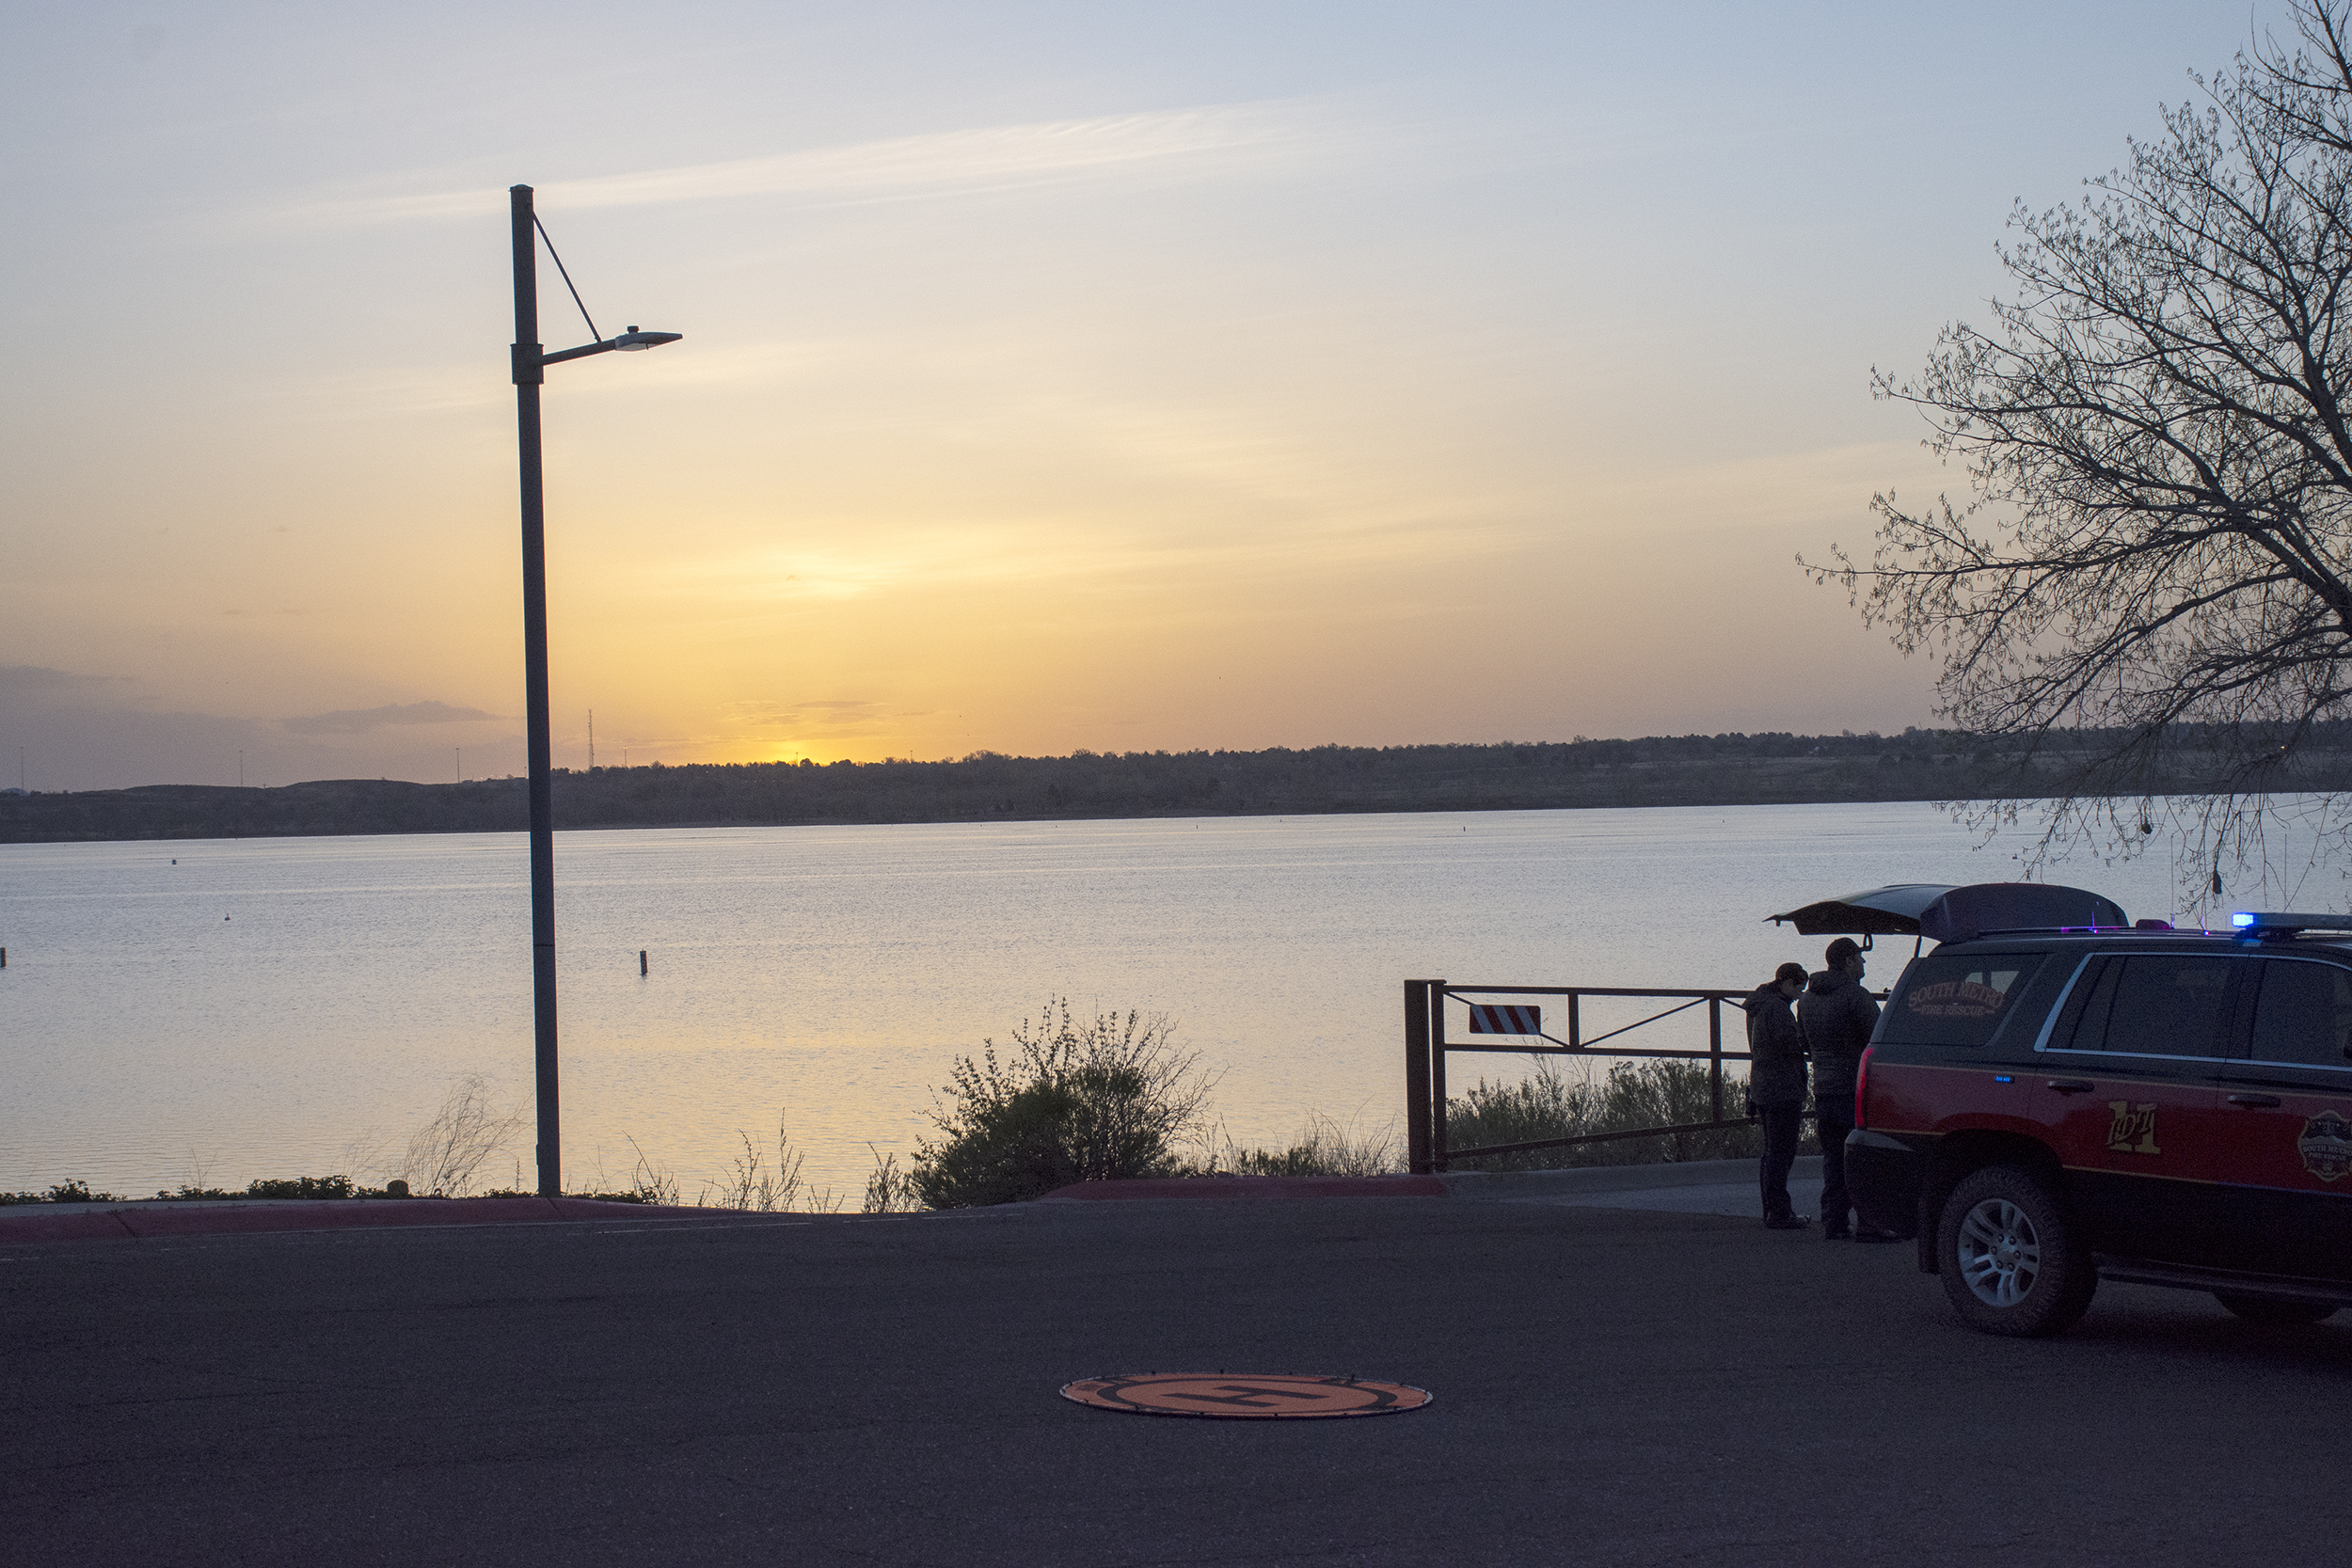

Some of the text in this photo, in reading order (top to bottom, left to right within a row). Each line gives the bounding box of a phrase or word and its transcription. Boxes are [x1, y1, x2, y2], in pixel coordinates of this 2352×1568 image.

[1908, 980, 2003, 1007] SOUTH METRO
[1920, 1005, 1984, 1015] FIRE RESCUE
[2302, 1144, 2327, 1153] SOUTH
[1161, 1385, 1330, 1407] H
